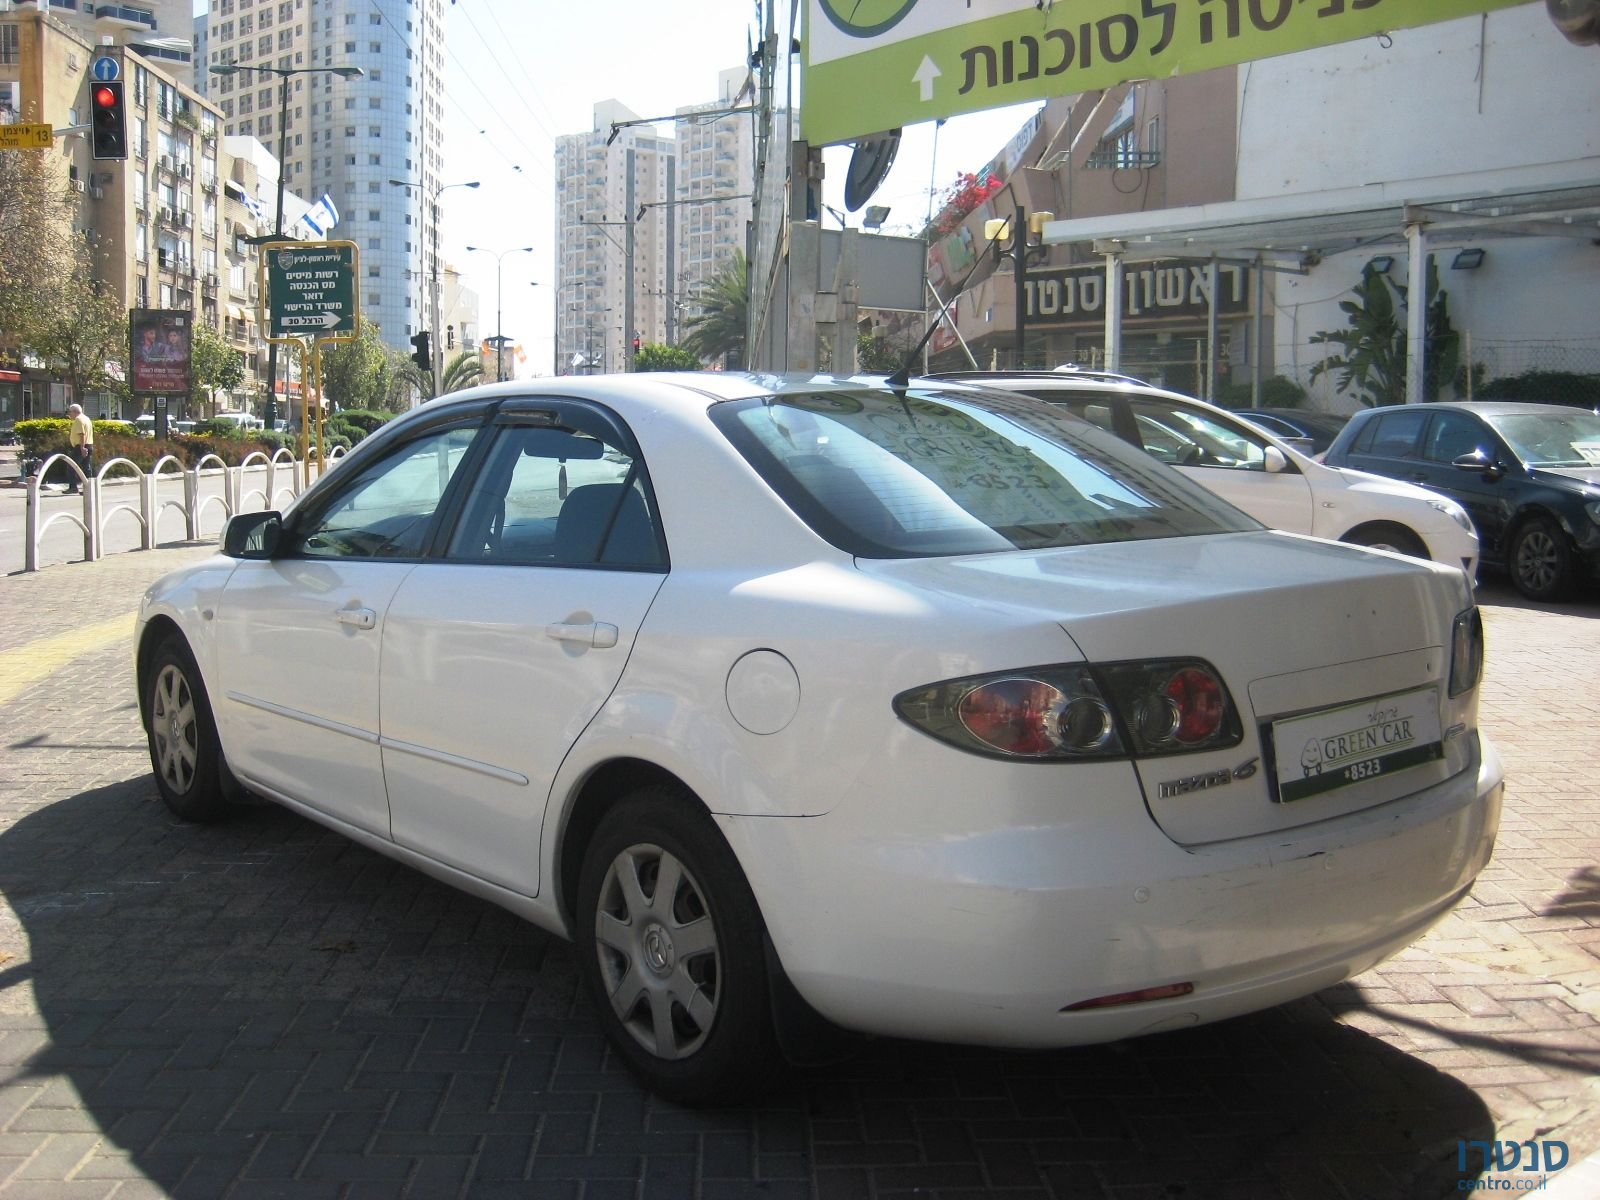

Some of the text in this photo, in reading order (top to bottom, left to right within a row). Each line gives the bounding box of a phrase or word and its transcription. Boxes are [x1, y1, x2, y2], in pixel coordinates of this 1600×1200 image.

[3, 127, 24, 137] ויצמן
[36, 130, 49, 142] 13
[286, 271, 339, 280] רשות מיסים
[289, 281, 336, 290] מס הכנסה
[1126, 265, 1243, 316] ראשון
[302, 292, 324, 301] דואר
[284, 302, 342, 311] משרד הרישוי
[302, 316, 324, 325] הרצל
[1325, 719, 1413, 760] GREEN CAR
